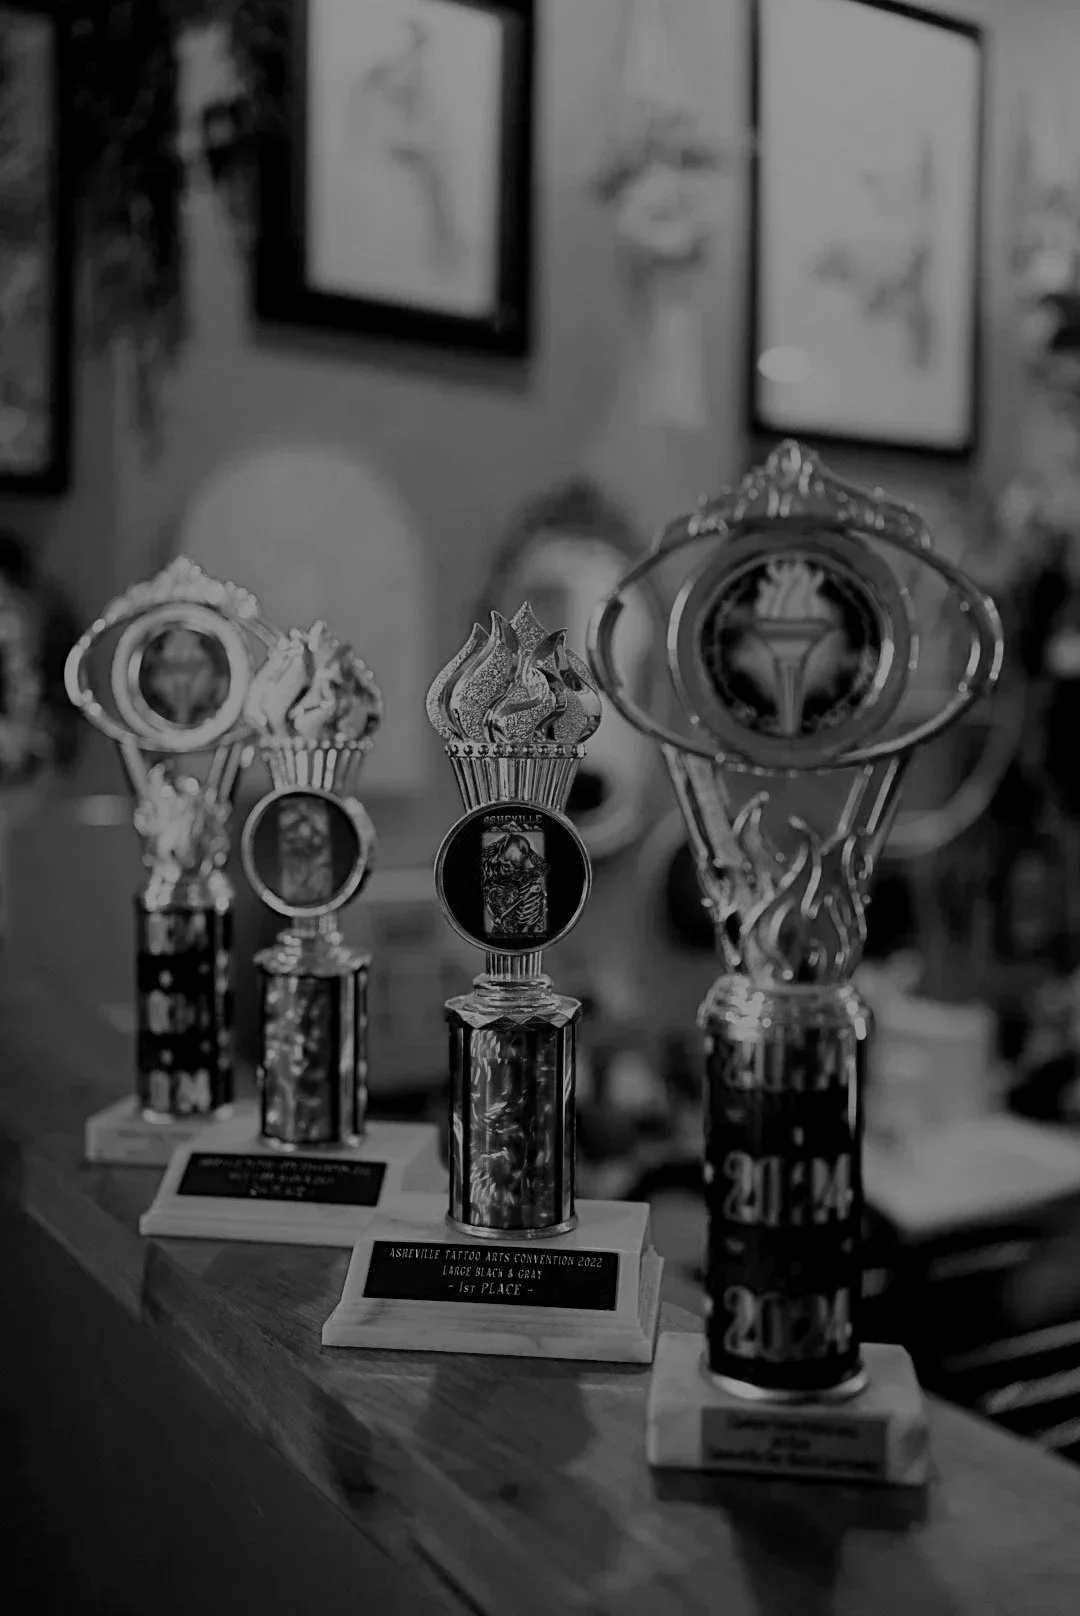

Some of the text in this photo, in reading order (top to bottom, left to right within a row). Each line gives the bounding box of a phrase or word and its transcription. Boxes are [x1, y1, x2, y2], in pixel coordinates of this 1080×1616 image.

[483, 814, 543, 824] ASHEVILLE
[389, 1247, 603, 1268] ASHEVILLE TATTOO ARTS CONVENTION 2022
[442, 1265, 543, 1281] LARGE BLACK & GRAY
[480, 1282, 523, 1296] PLACE
[722, 1284, 854, 1363] 2024
